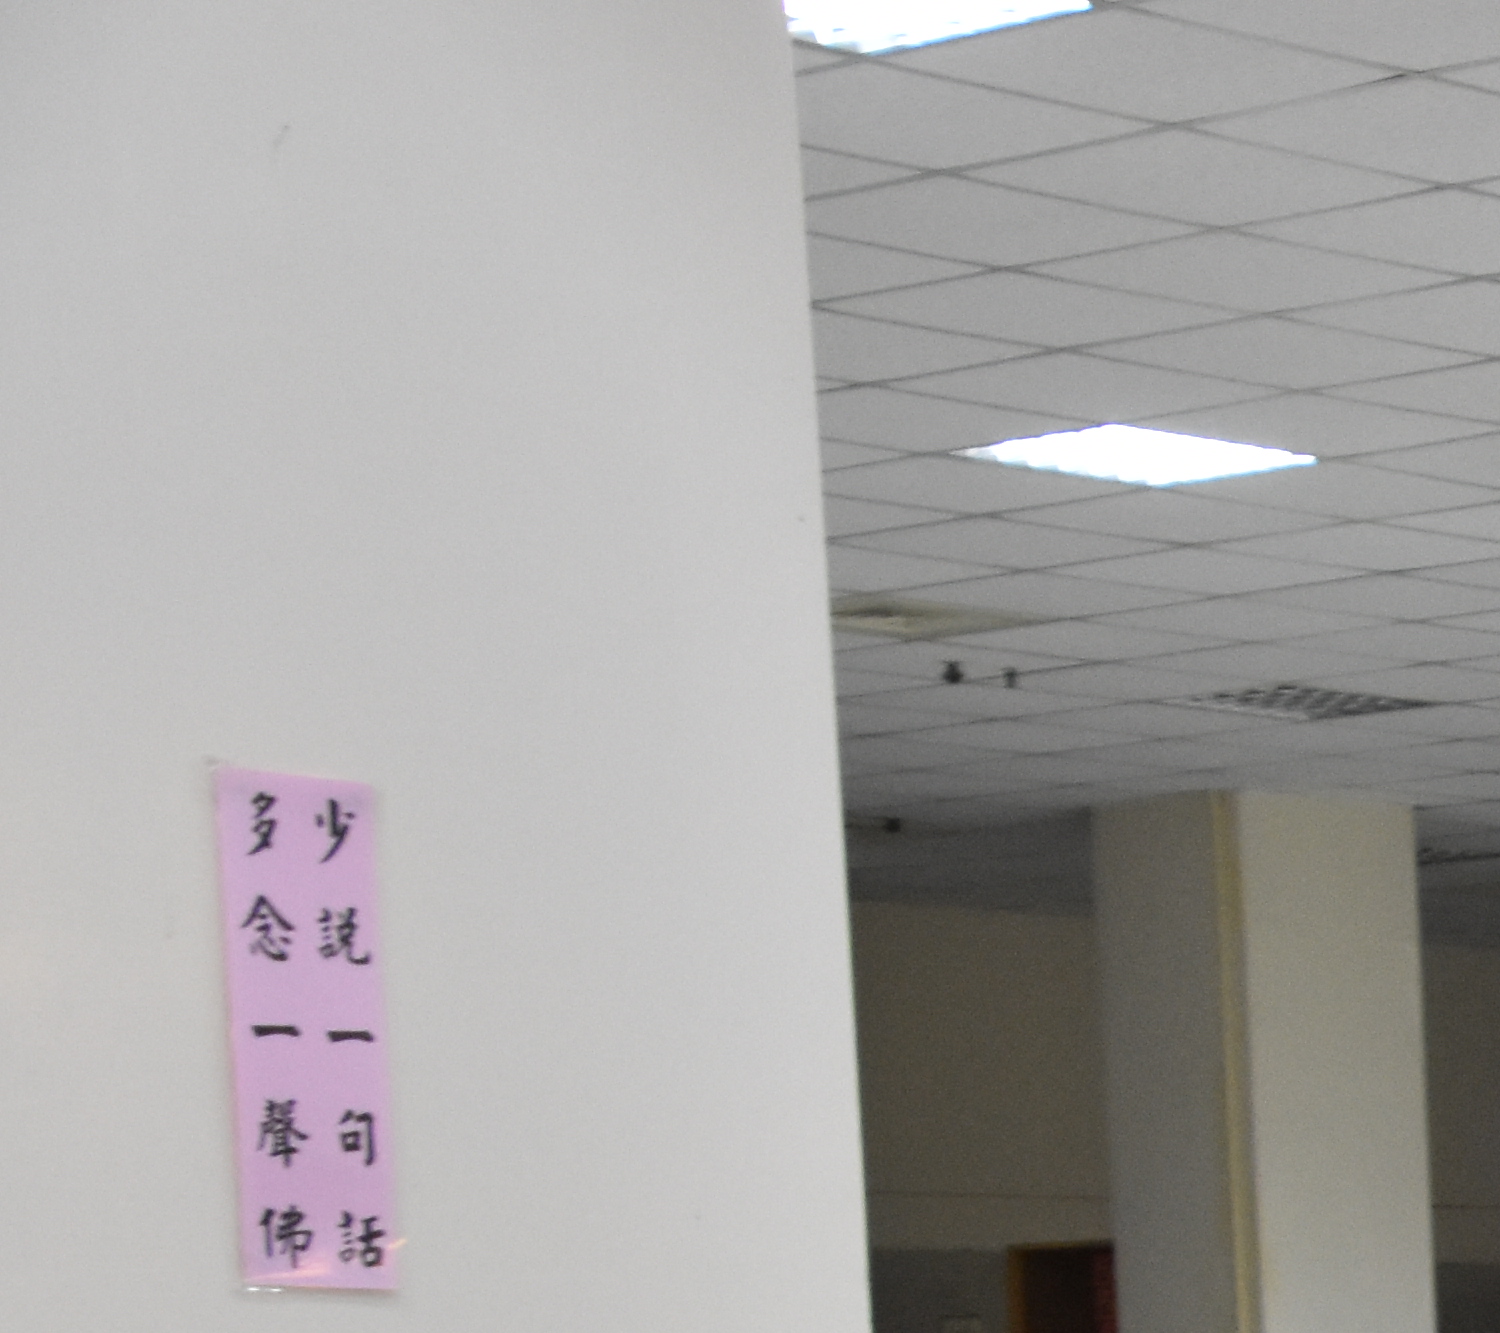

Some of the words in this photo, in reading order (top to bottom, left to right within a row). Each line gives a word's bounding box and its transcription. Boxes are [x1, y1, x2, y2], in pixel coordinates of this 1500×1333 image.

[240, 791, 314, 1271] 多念一聲佛
